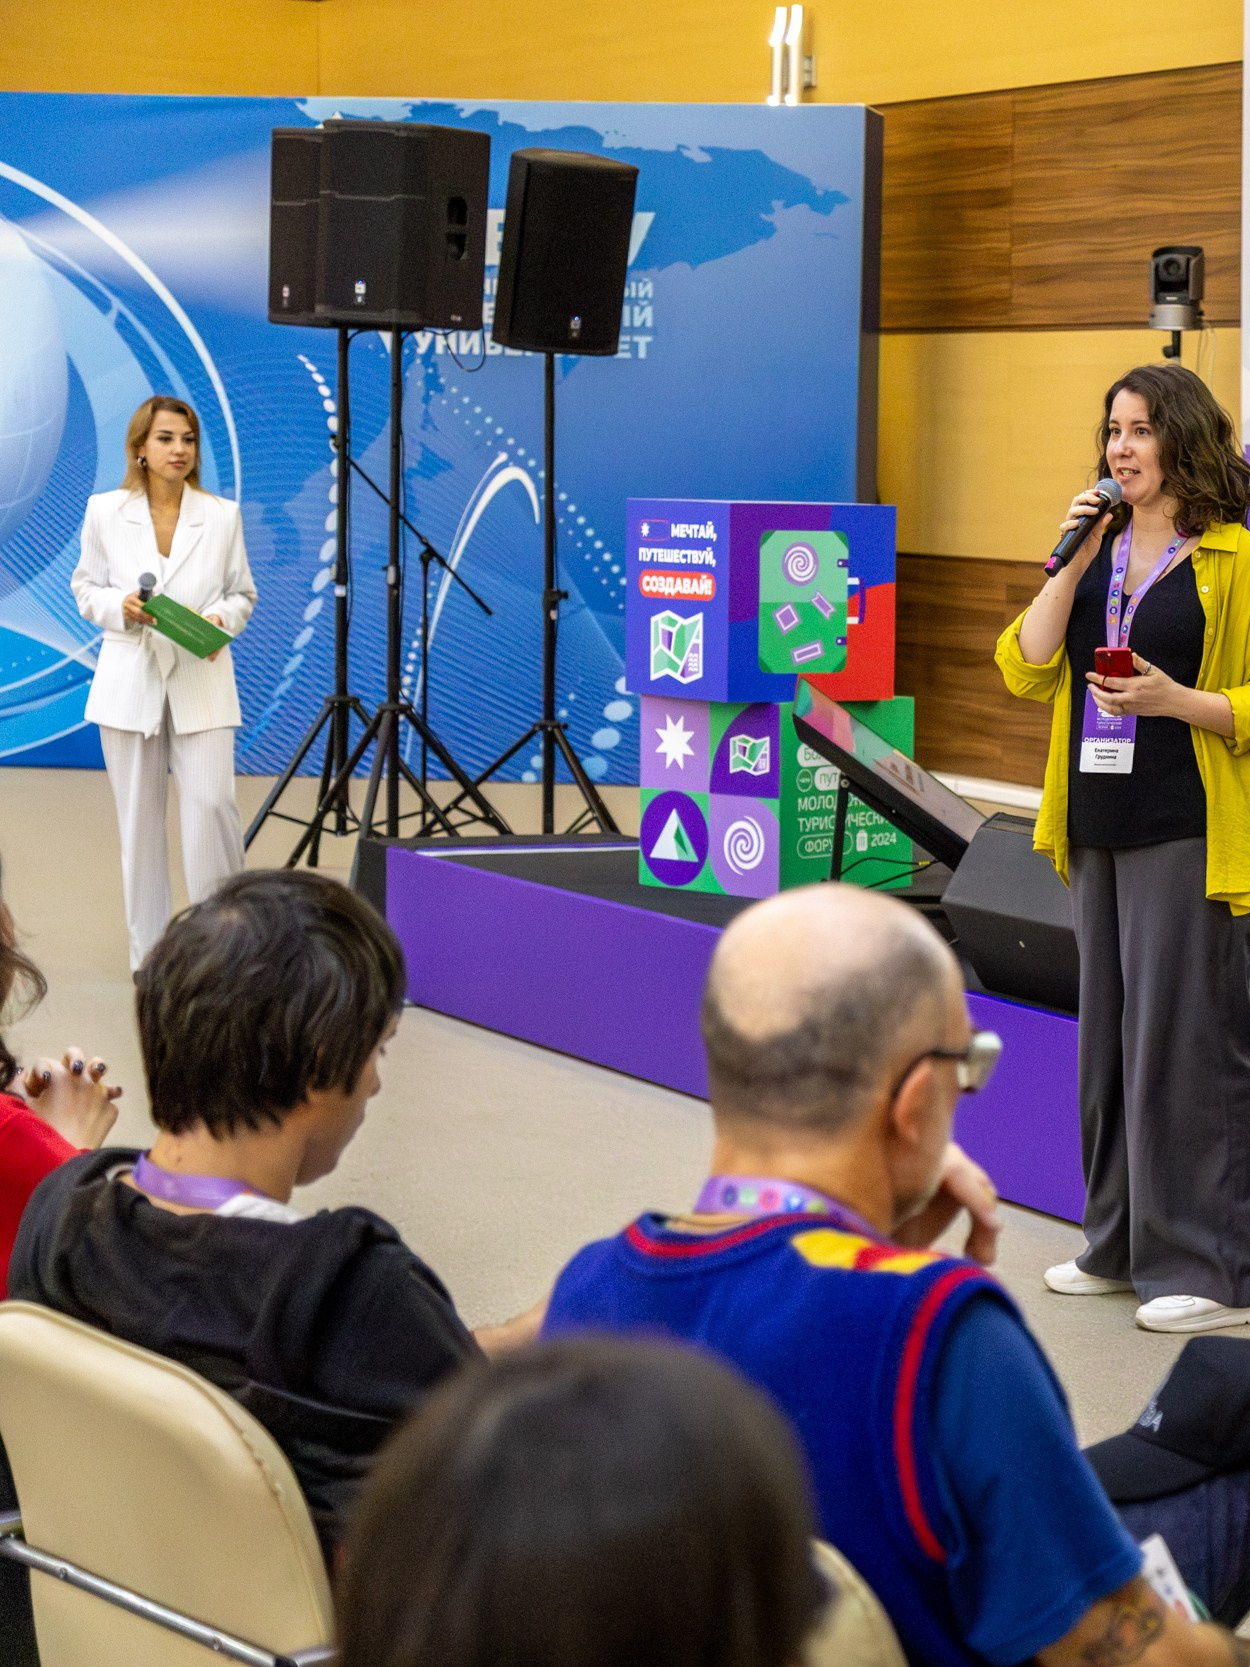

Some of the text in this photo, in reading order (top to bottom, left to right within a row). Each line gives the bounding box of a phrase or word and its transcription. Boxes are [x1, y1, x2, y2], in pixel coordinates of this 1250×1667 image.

[670, 521, 717, 542] МЕЧТАЙ,
[638, 546, 717, 568] ПУТЕШЕСТВУЙ,
[642, 574, 713, 596] СОЗДАВАЙ!
[871, 832, 897, 847] 2024
